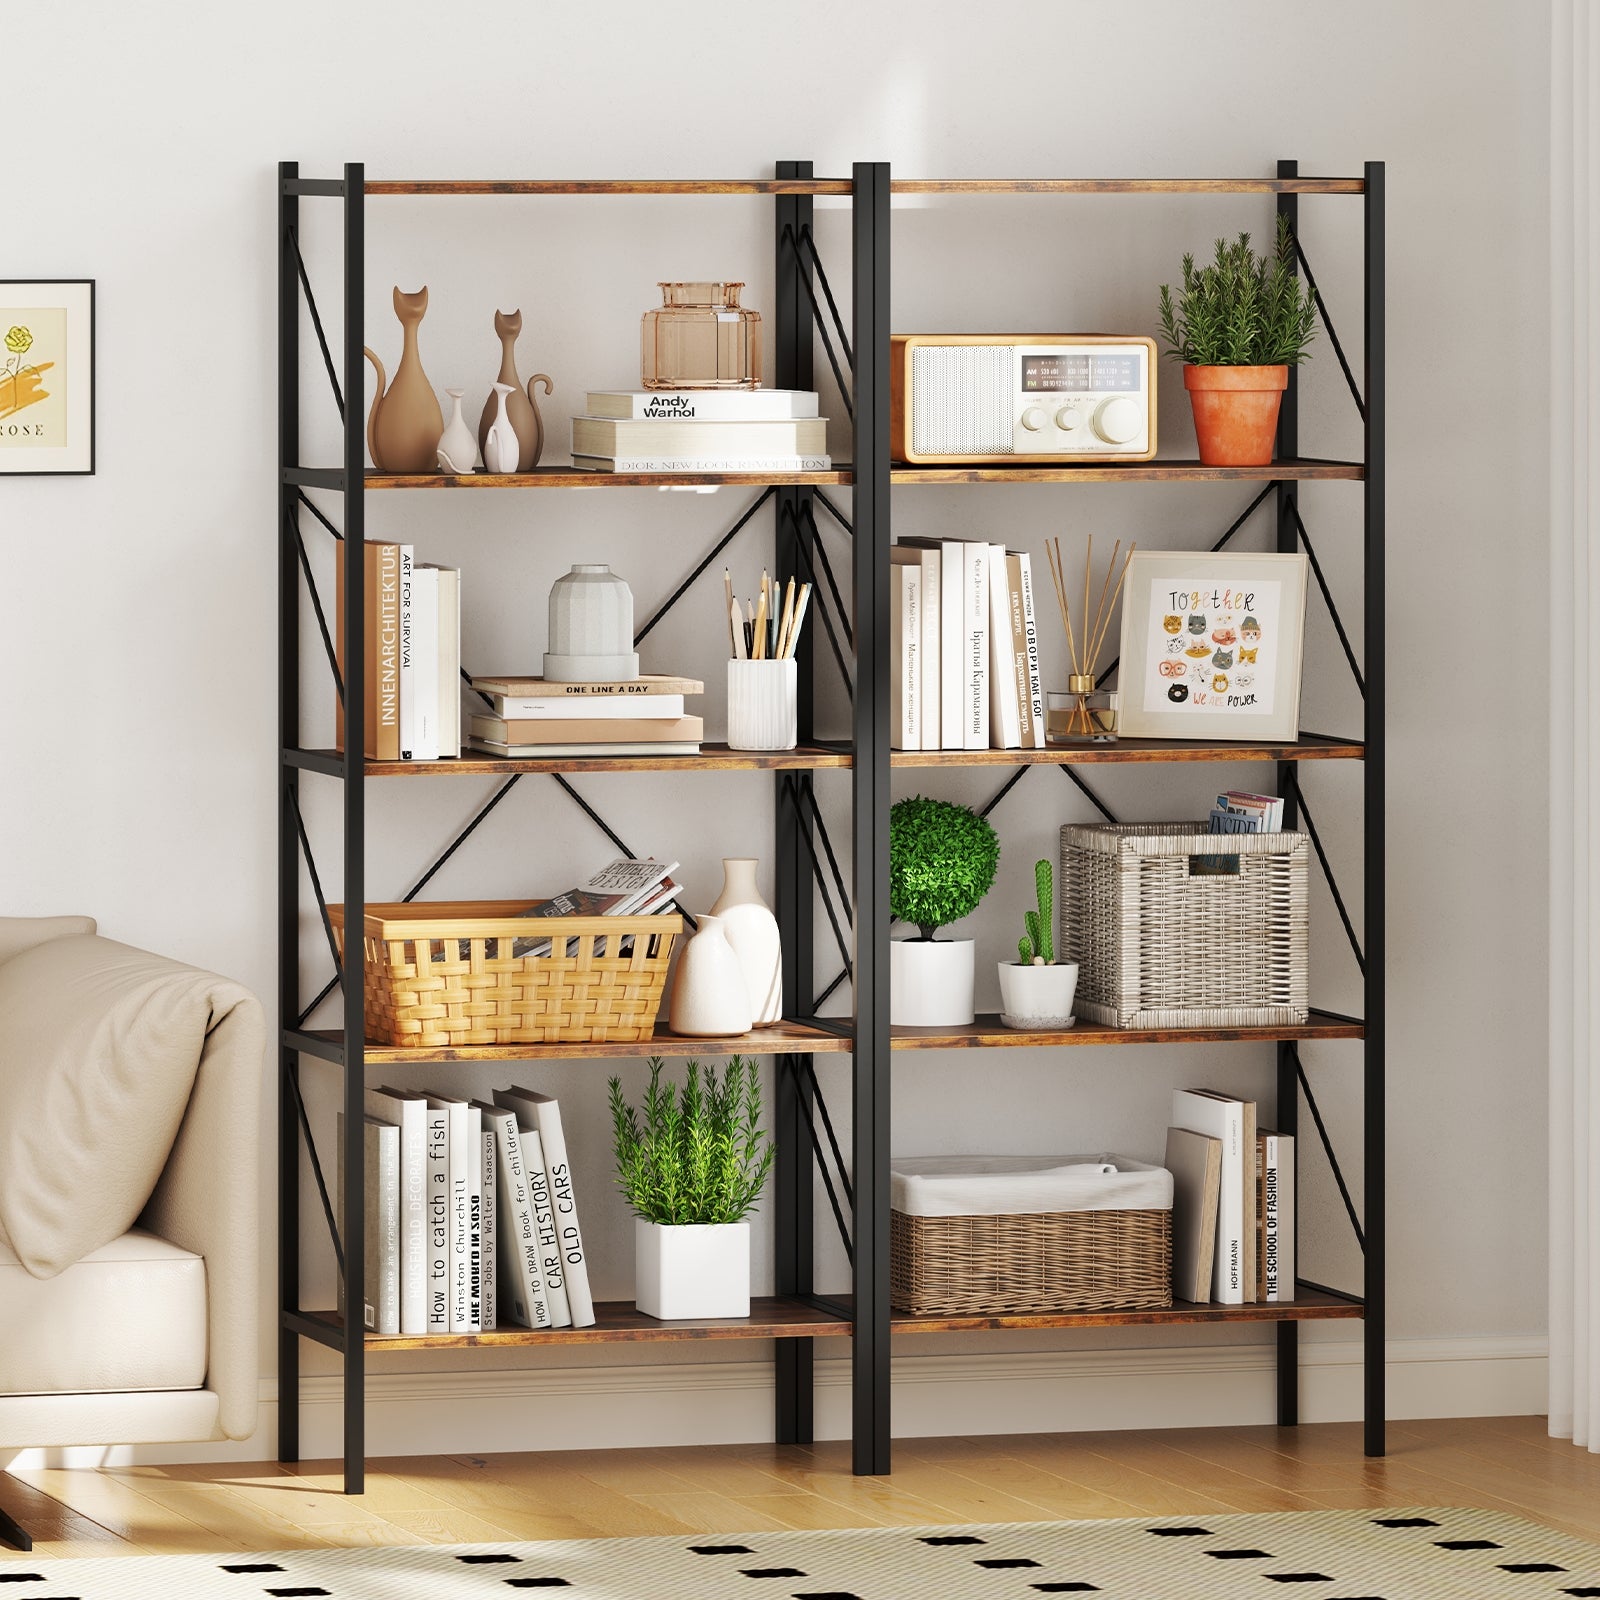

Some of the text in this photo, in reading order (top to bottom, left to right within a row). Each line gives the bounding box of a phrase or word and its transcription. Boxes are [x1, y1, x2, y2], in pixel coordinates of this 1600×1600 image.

[643, 407, 695, 418] Warhol
[650, 396, 689, 409] Andy
[662, 461, 691, 470] NEW
[696, 460, 734, 470] LOOK
[402, 554, 411, 669] ART FOR SURVIVAL
[381, 545, 396, 726] INNENARCHITEKTUR
[970, 630, 984, 668] Братья
[1026, 620, 1038, 671] ГОВОРИ
[628, 685, 649, 693] DAY
[1015, 652, 1028, 701] Бархатная
[1030, 675, 1040, 696] КАК
[970, 670, 984, 735] Карамазовы
[1019, 702, 1031, 734] смерть
[1033, 699, 1042, 719] БОГ
[387, 1181, 395, 1191] in
[409, 1132, 423, 1210] DECORATES
[1267, 1168, 1277, 1212] FASHION
[387, 1196, 395, 1251] arrangement
[429, 1119, 445, 1323] How to catch a fish
[484, 1134, 494, 1326] Steve Jobs by Walter Isaacson
[506, 1120, 546, 1322] HOW TO DRAW Book for children
[529, 1170, 563, 1289] CAR HISTORY
[552, 1163, 582, 1264] OLD CARS
[1267, 1215, 1277, 1229] OF
[455, 1178, 465, 1322] Winston Churchill
[471, 1236, 480, 1248] IN
[1267, 1231, 1277, 1273] SCHOOL
[387, 1256, 395, 1266] an
[387, 1271, 395, 1291] make
[1267, 1275, 1277, 1295] THE
[387, 1296, 395, 1306] to
[387, 1311, 395, 1326] How
[471, 1302, 480, 1326] THE
